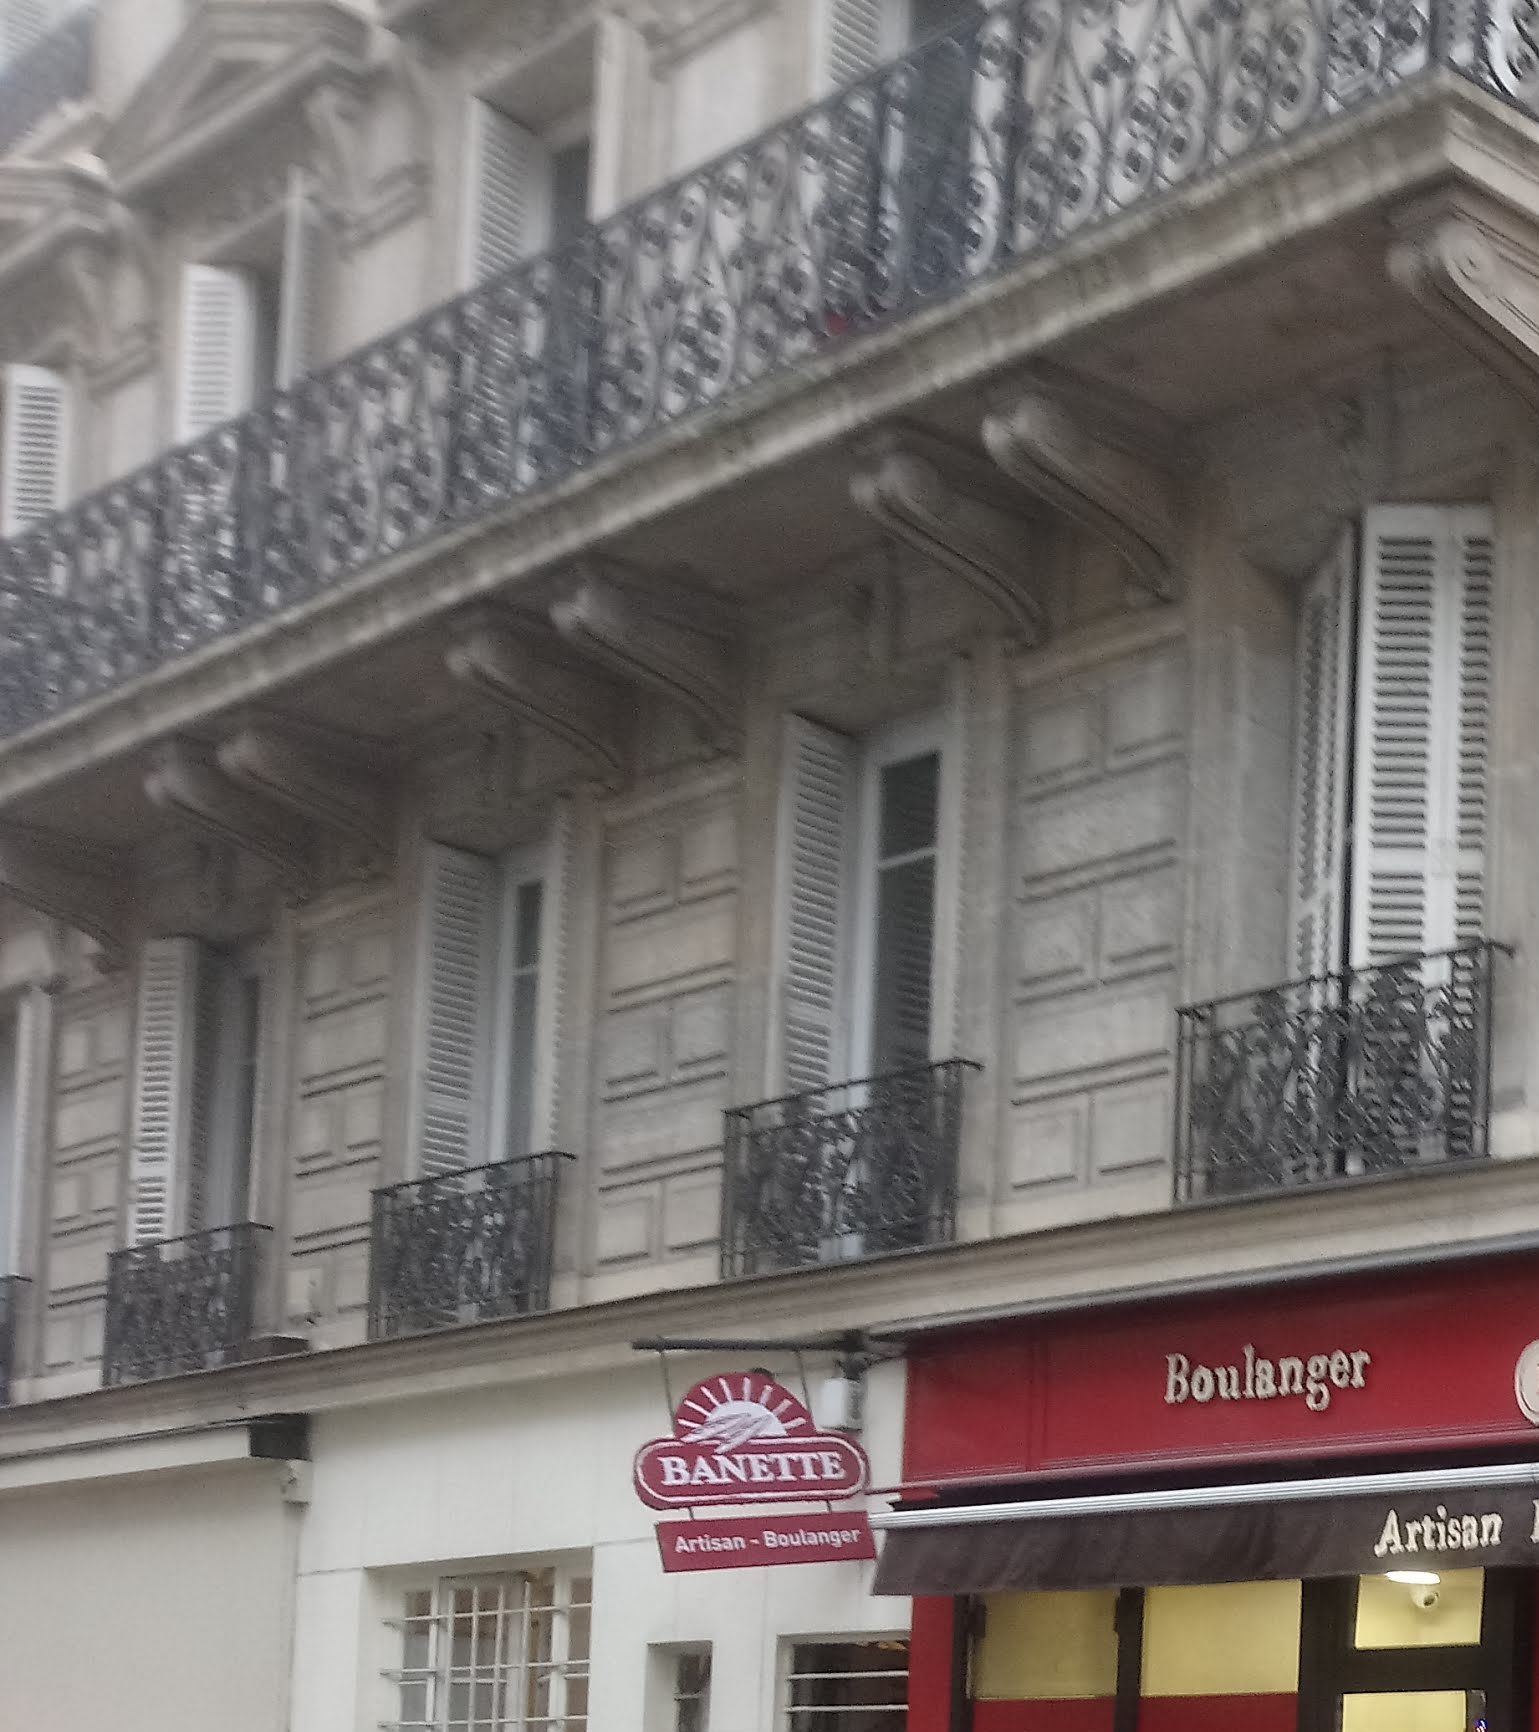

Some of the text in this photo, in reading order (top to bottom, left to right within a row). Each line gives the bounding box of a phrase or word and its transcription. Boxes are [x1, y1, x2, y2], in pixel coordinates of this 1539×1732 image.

[1164, 1343, 1370, 1411] Boulanger
[657, 1451, 847, 1487] BANETTE
[675, 1528, 861, 1554] Artisan Boulanger
[1374, 1505, 1503, 1557] Artisan
